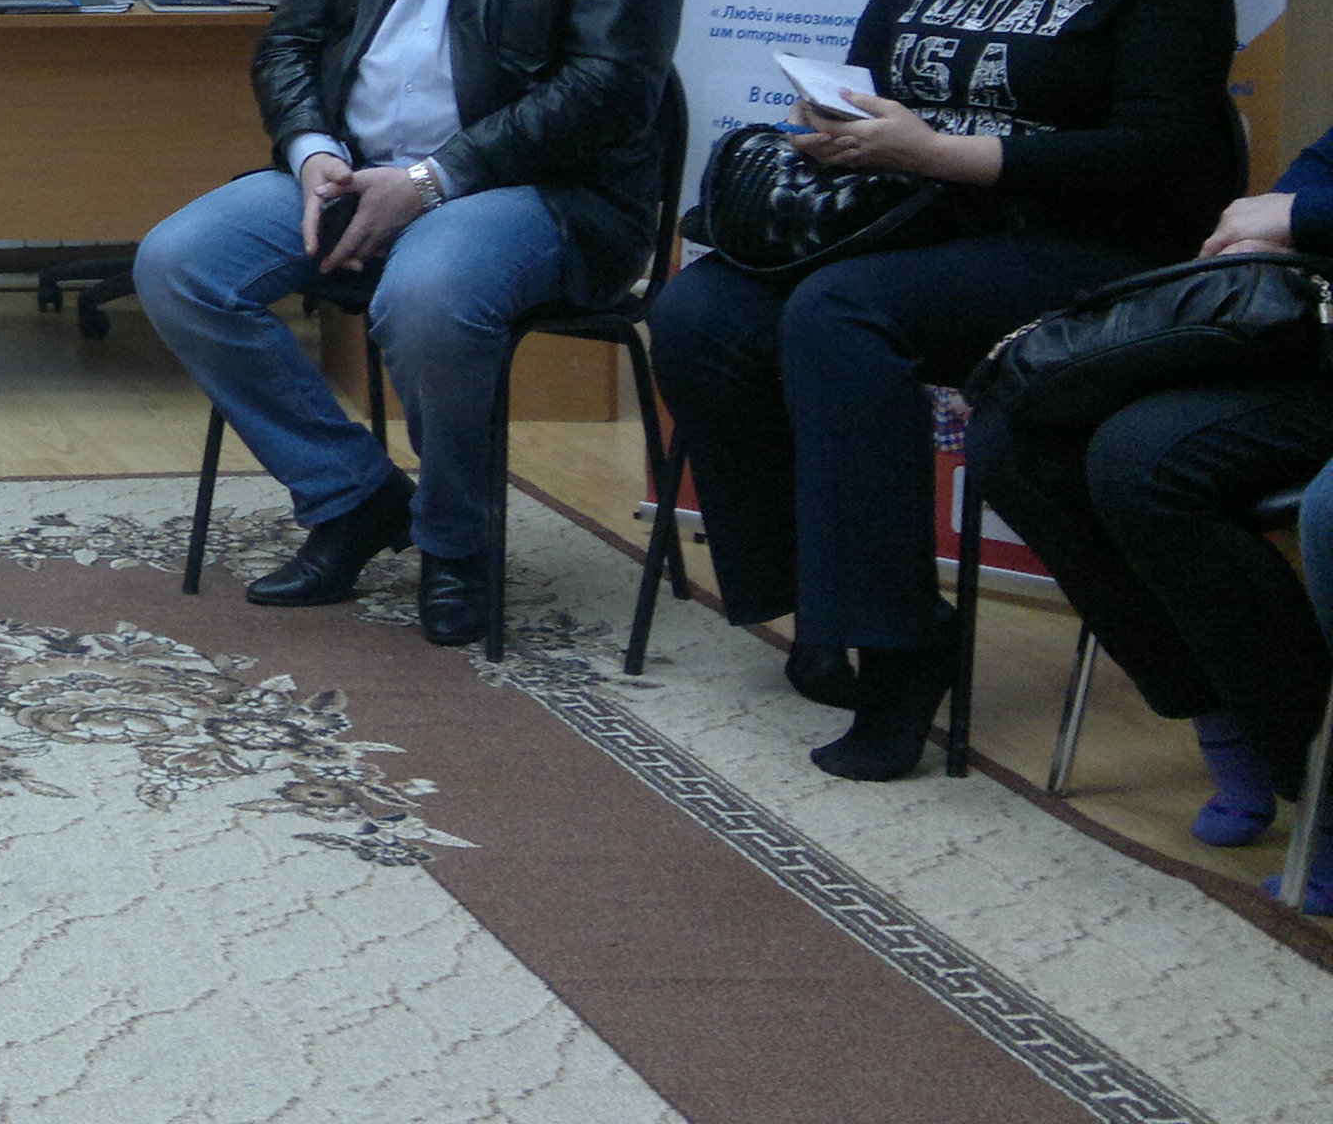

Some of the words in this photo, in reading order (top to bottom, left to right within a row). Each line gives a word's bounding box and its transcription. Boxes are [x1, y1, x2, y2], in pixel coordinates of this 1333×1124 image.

[722, 5, 772, 23] Людей
[775, 12, 862, 27] невозмож
[709, 27, 733, 38] им
[736, 27, 812, 45] открыть
[890, 33, 961, 102] IS
[968, 42, 1017, 111] A
[749, 85, 760, 104] В
